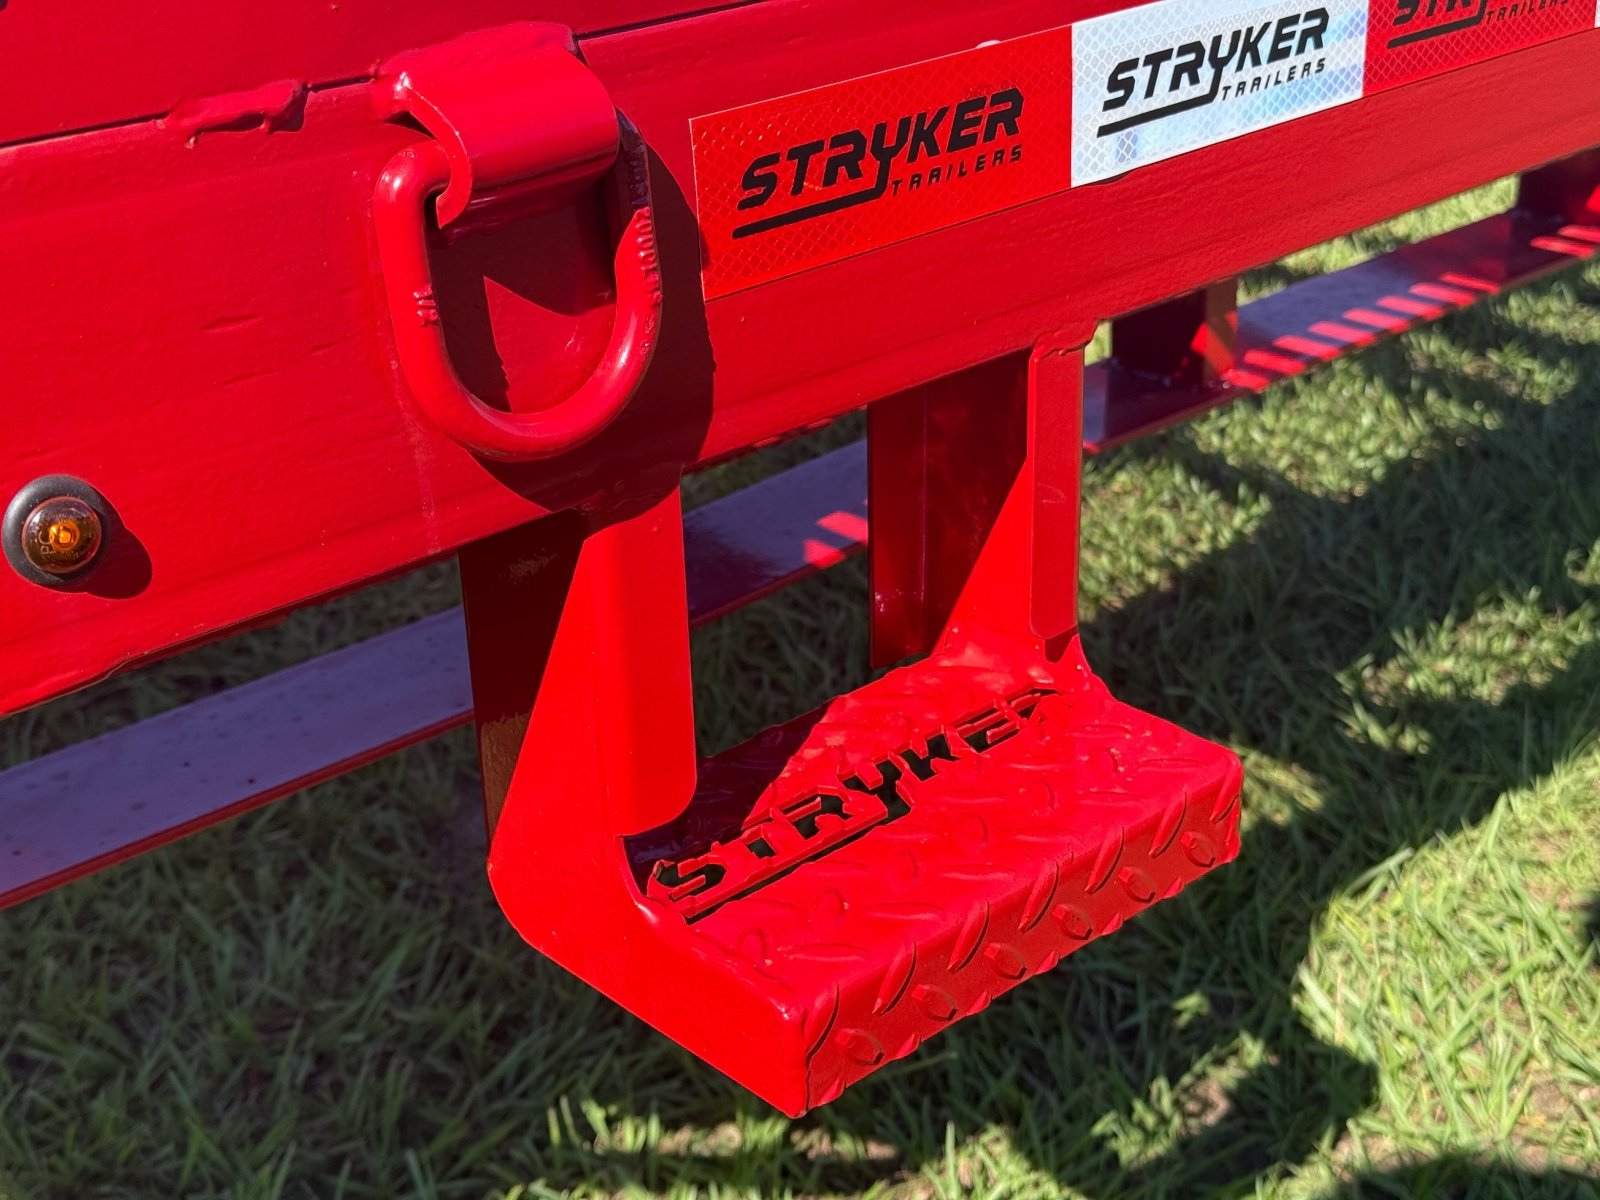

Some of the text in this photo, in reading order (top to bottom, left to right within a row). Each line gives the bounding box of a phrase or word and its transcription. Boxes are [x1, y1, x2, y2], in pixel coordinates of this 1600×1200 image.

[1097, 8, 1329, 138] STRYKER
[1222, 57, 1326, 101] TRAILERS
[732, 88, 1024, 239] STRYKER
[891, 144, 1022, 196] TRAILERS
